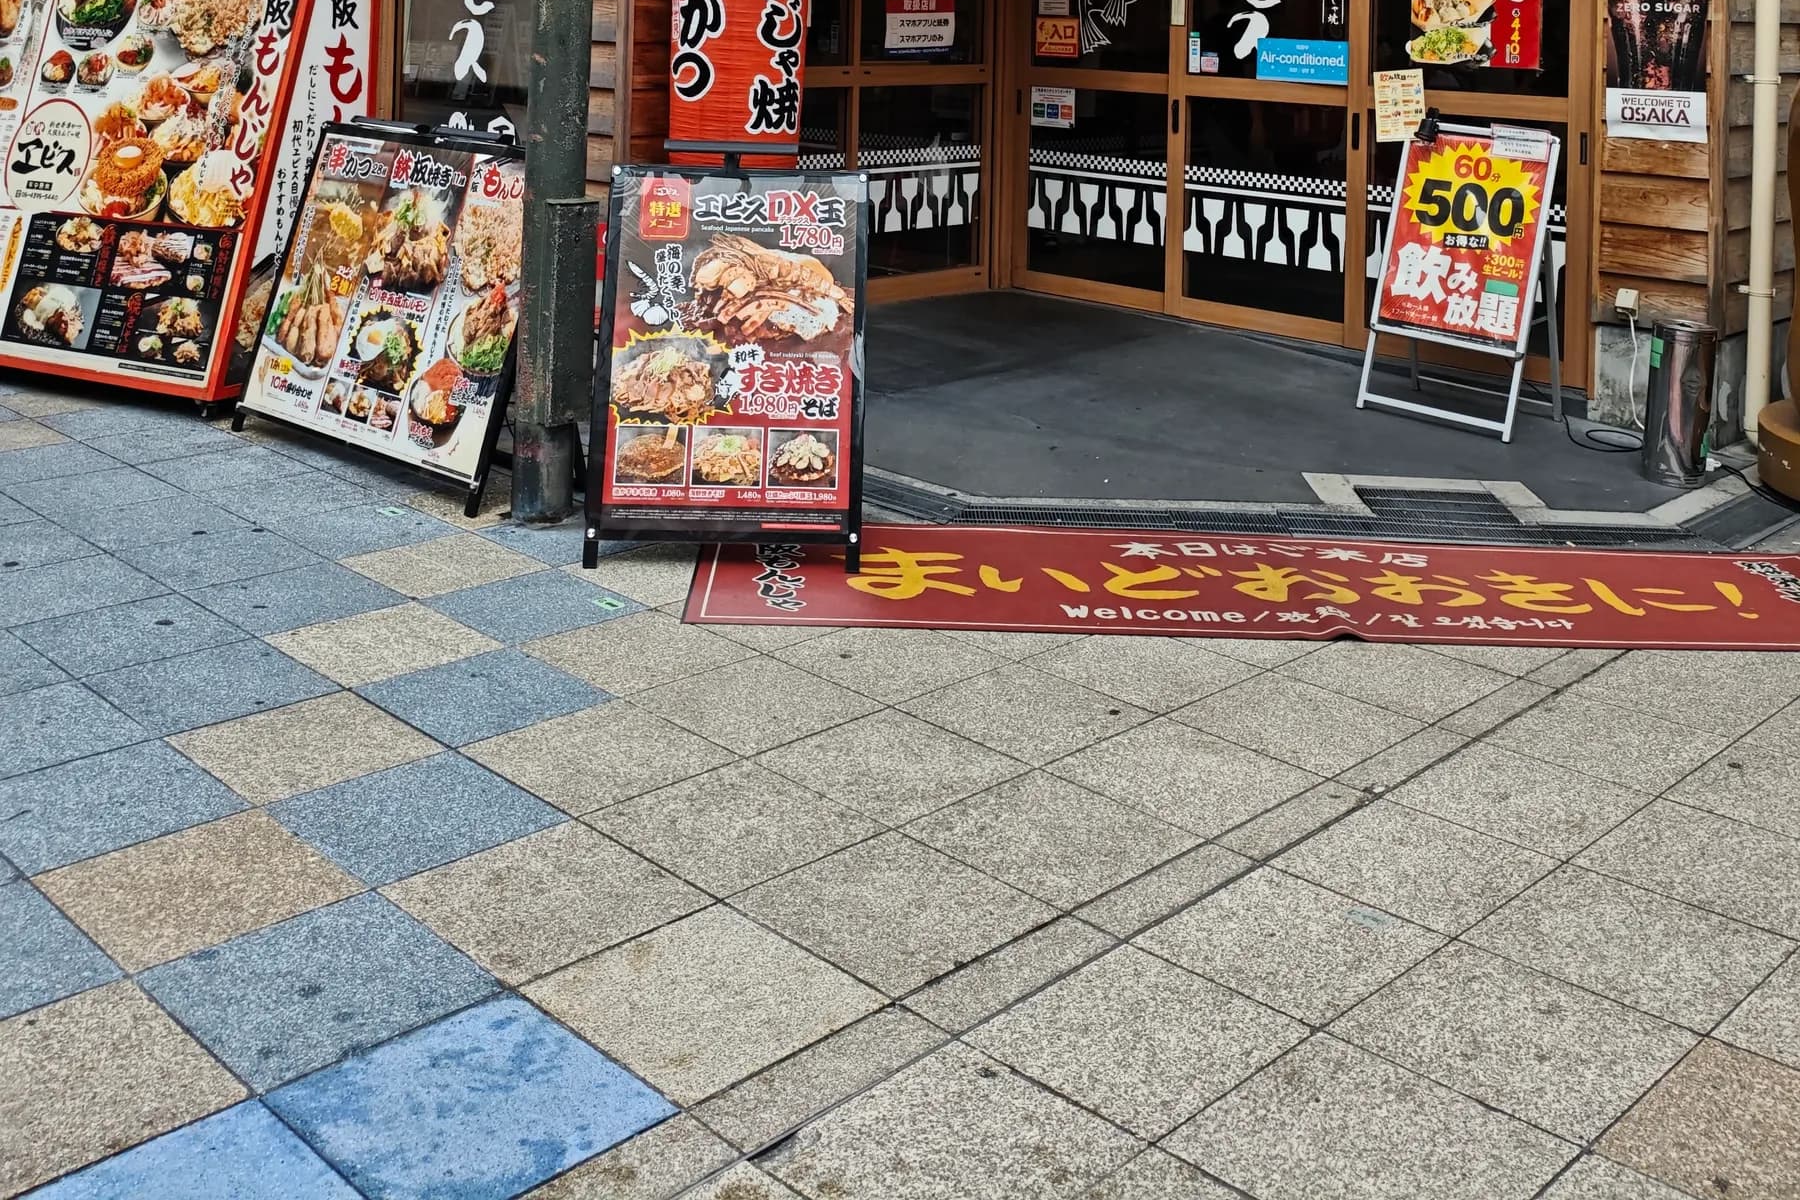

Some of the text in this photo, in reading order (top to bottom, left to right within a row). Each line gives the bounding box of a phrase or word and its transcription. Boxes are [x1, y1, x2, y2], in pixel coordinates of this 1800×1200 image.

[1615, 2, 1700, 13] ZERO SUGAR
[1621, 96, 1691, 109] WELCOME TO
[1620, 106, 1691, 125] OSAKA
[327, 142, 373, 179] 串かつ
[391, 149, 453, 190] 鉄板焼き
[649, 201, 682, 218] 特選
[648, 218, 683, 229] メニュー
[737, 362, 842, 396] すき焼き
[801, 396, 839, 418] そば
[1110, 540, 1430, 569] 本日はご来店
[1059, 603, 1247, 624] Welcome
